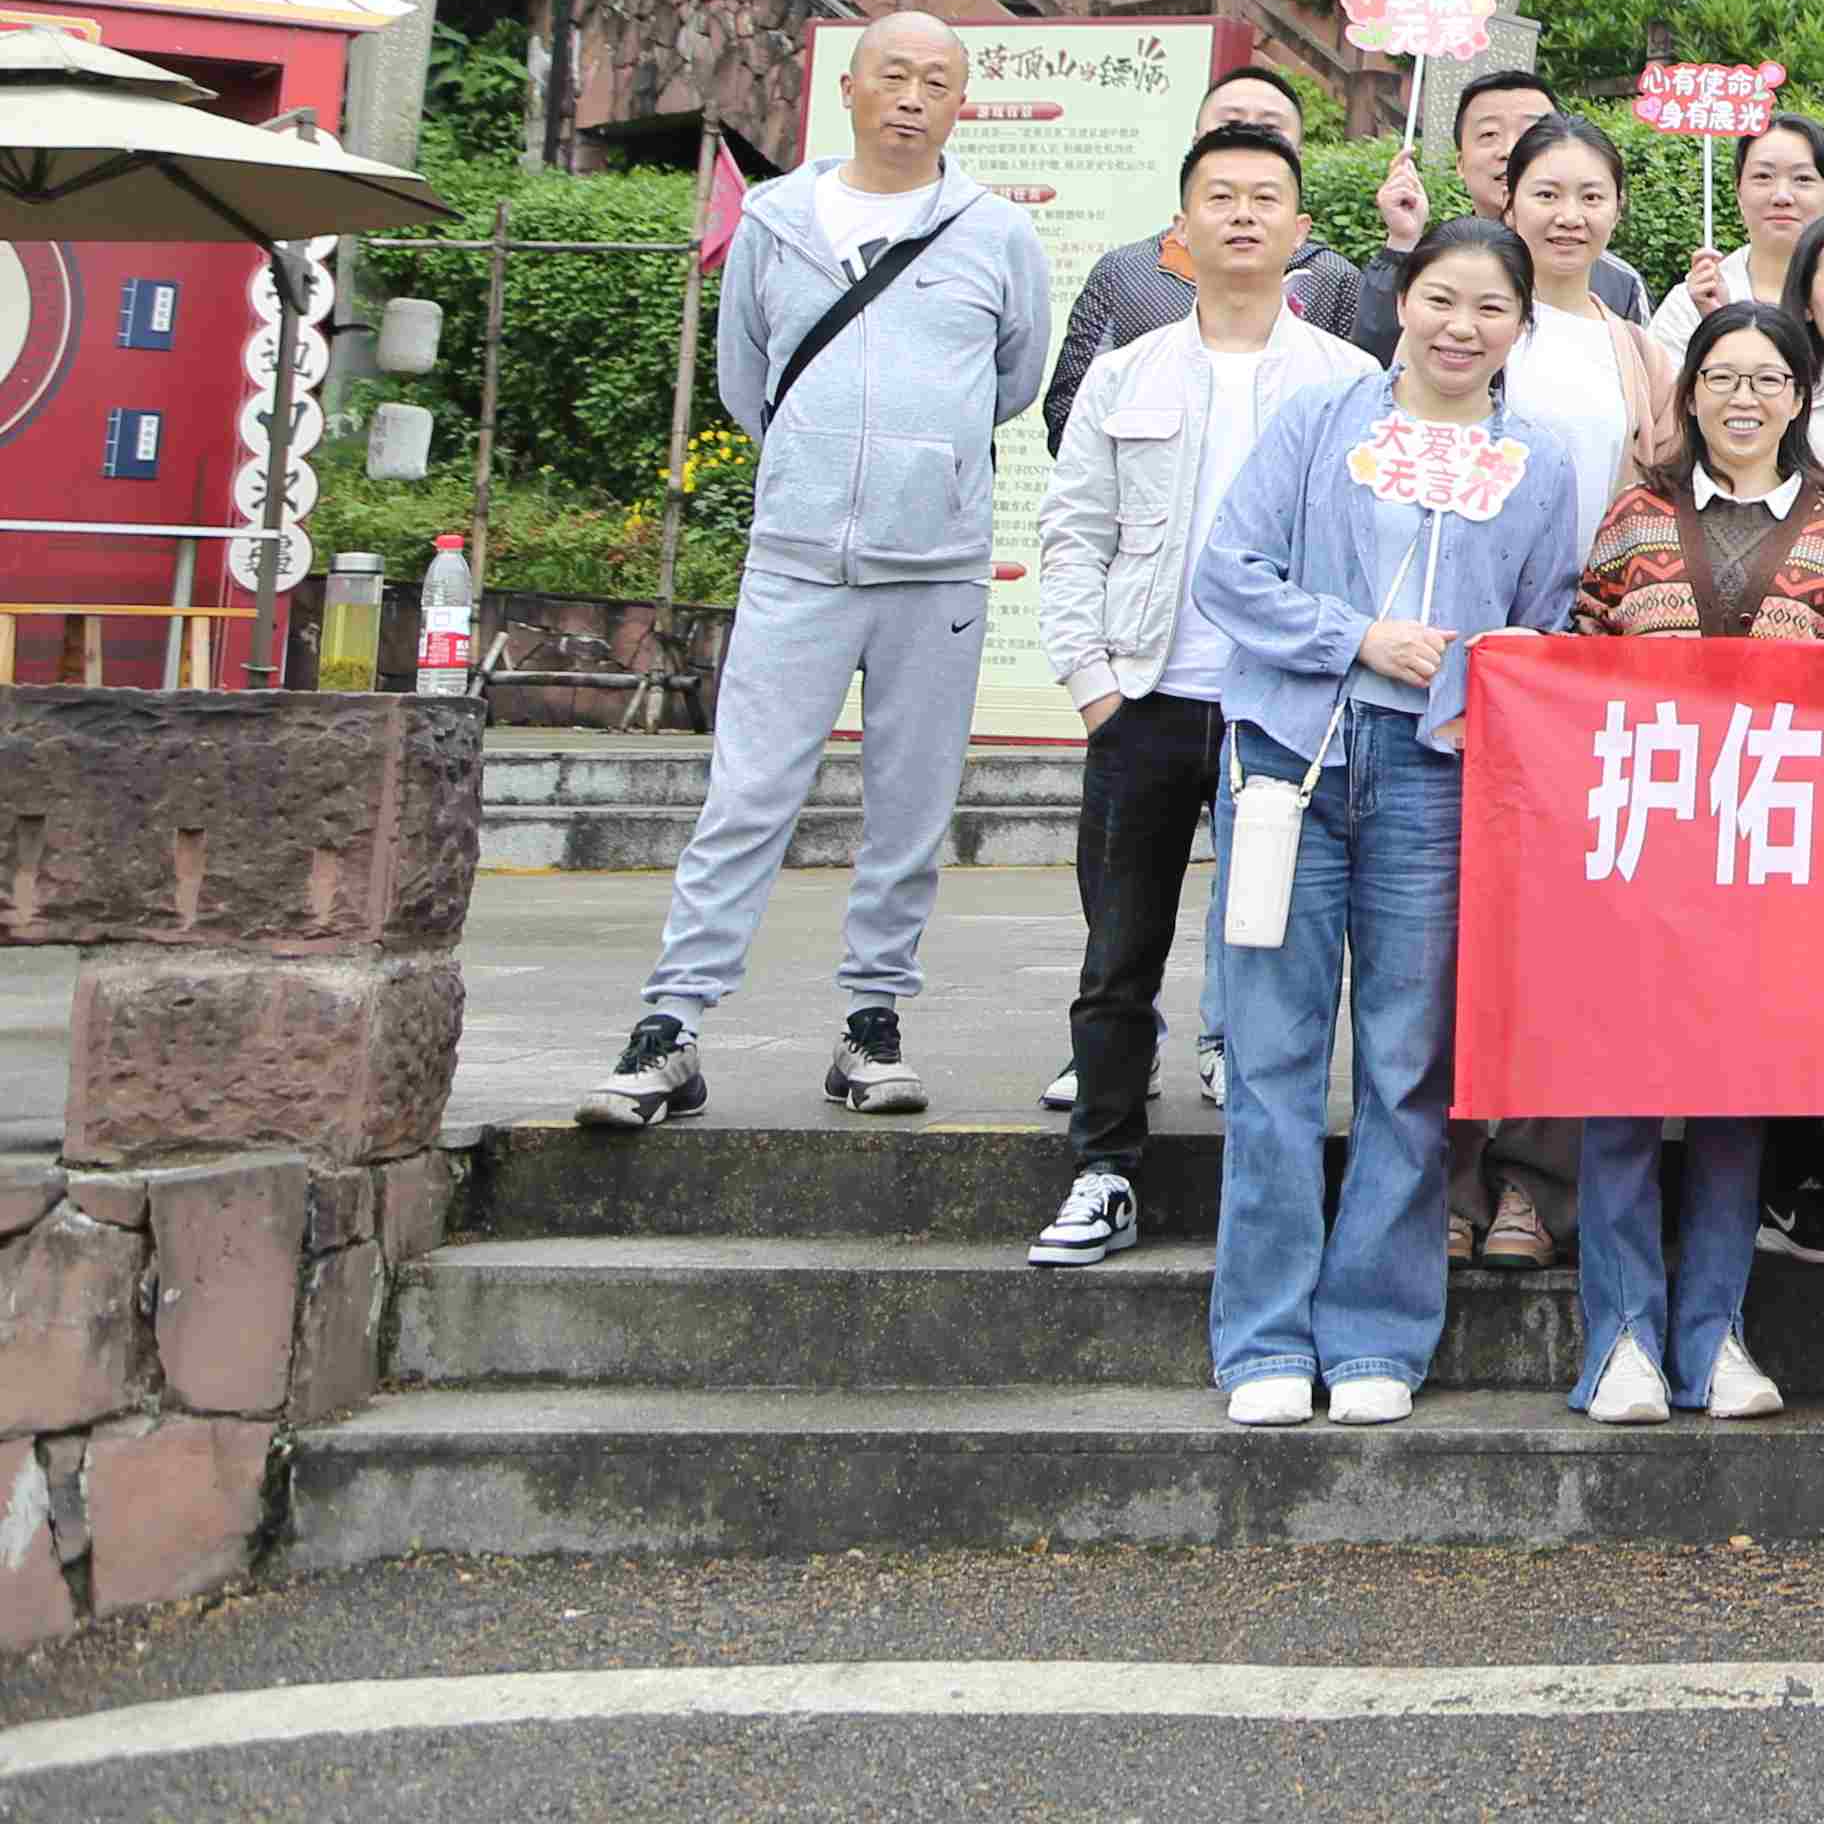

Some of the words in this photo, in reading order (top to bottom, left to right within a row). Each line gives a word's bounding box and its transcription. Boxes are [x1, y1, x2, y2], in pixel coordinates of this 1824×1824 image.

[1643, 66, 1754, 96] 心有使命
[1658, 99, 1765, 132] 身有晨光
[1374, 417, 1458, 465] 大爱
[1378, 459, 1460, 505] 无言
